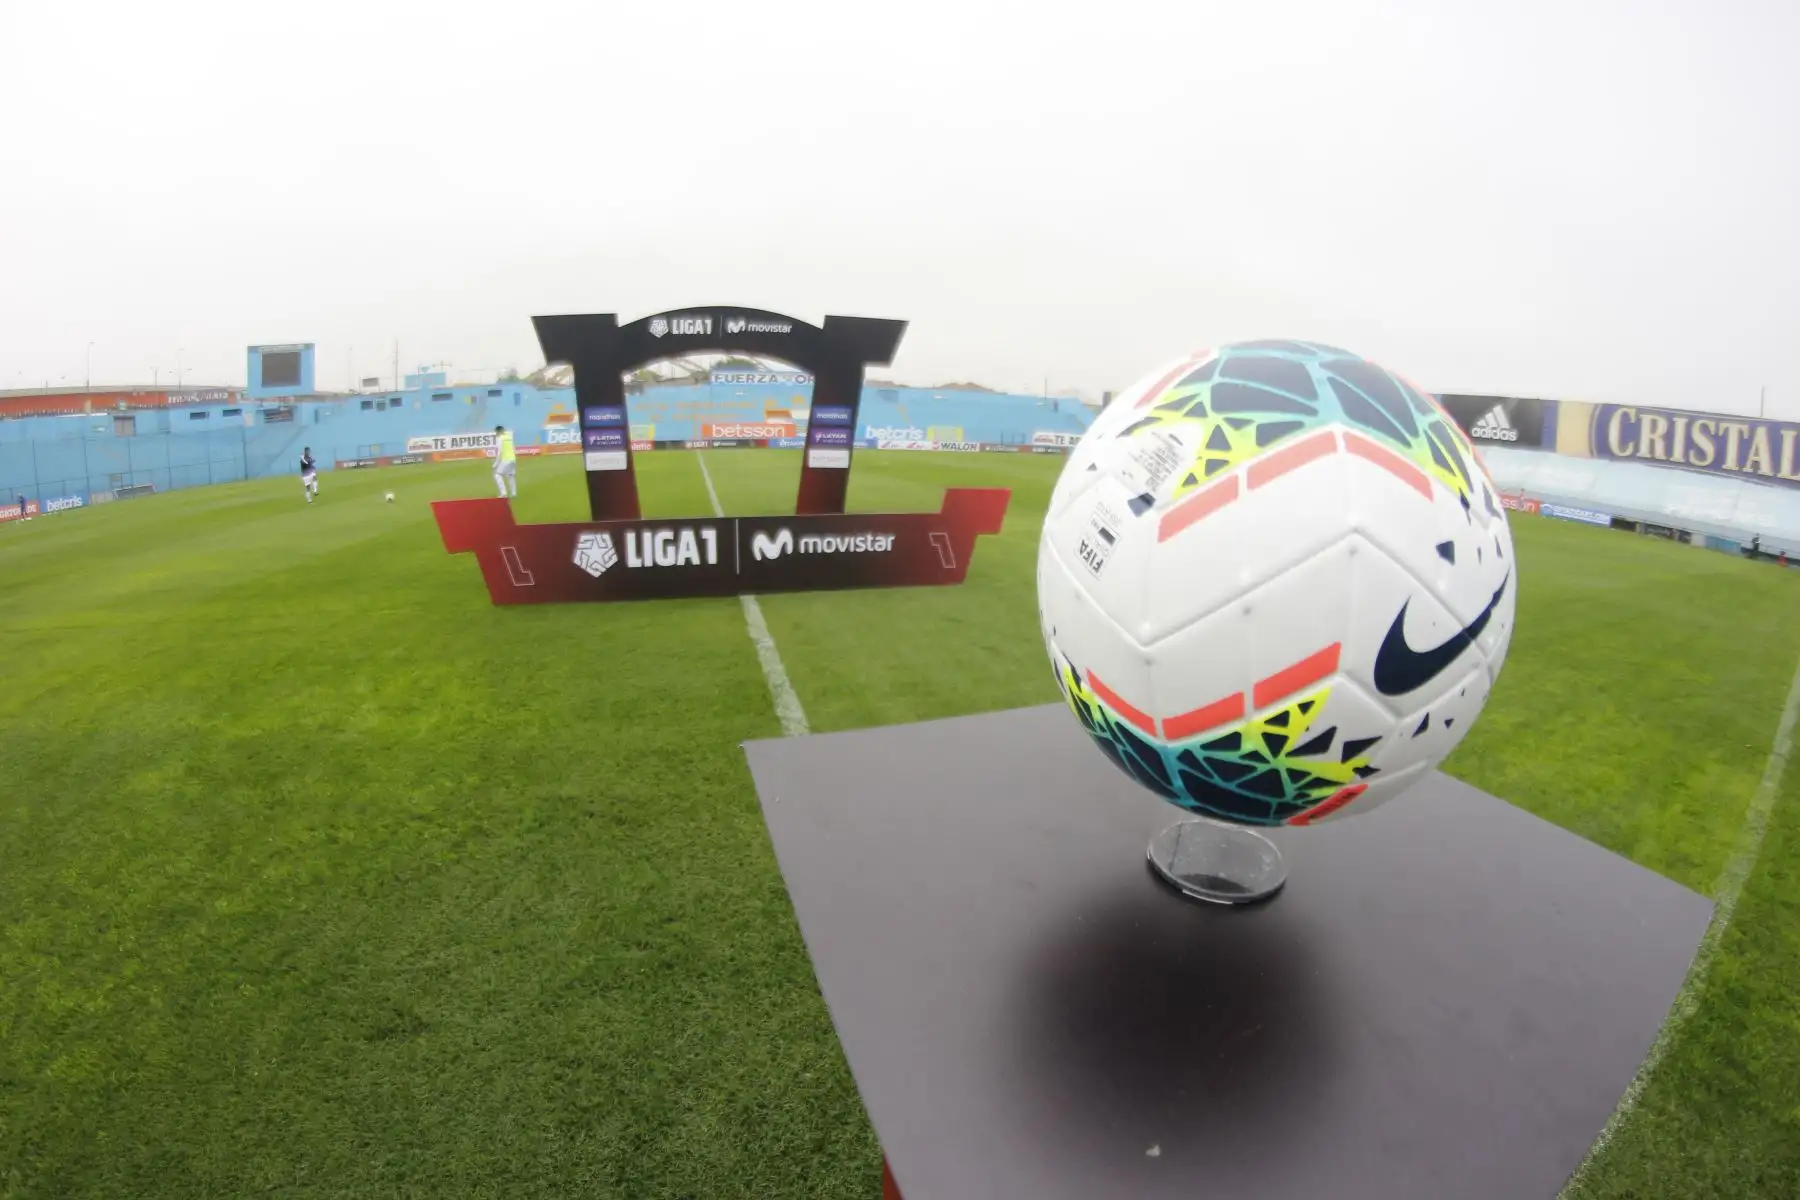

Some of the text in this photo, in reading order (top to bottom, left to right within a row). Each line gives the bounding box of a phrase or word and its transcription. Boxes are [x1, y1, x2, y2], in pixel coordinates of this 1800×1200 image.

[672, 319, 712, 335] LIGA1
[747, 324, 793, 334] movistar
[714, 373, 779, 385] FUERZA
[711, 423, 786, 438] betsson
[1471, 425, 1517, 442] adidas
[432, 437, 447, 450] TE
[451, 434, 497, 448] APUEST
[1607, 407, 1800, 481] CRISTAL
[0, 504, 37, 519] GATORDE
[624, 529, 717, 568] LIGA1
[799, 532, 896, 554] movistar
[1078, 538, 1105, 574] FIFA
